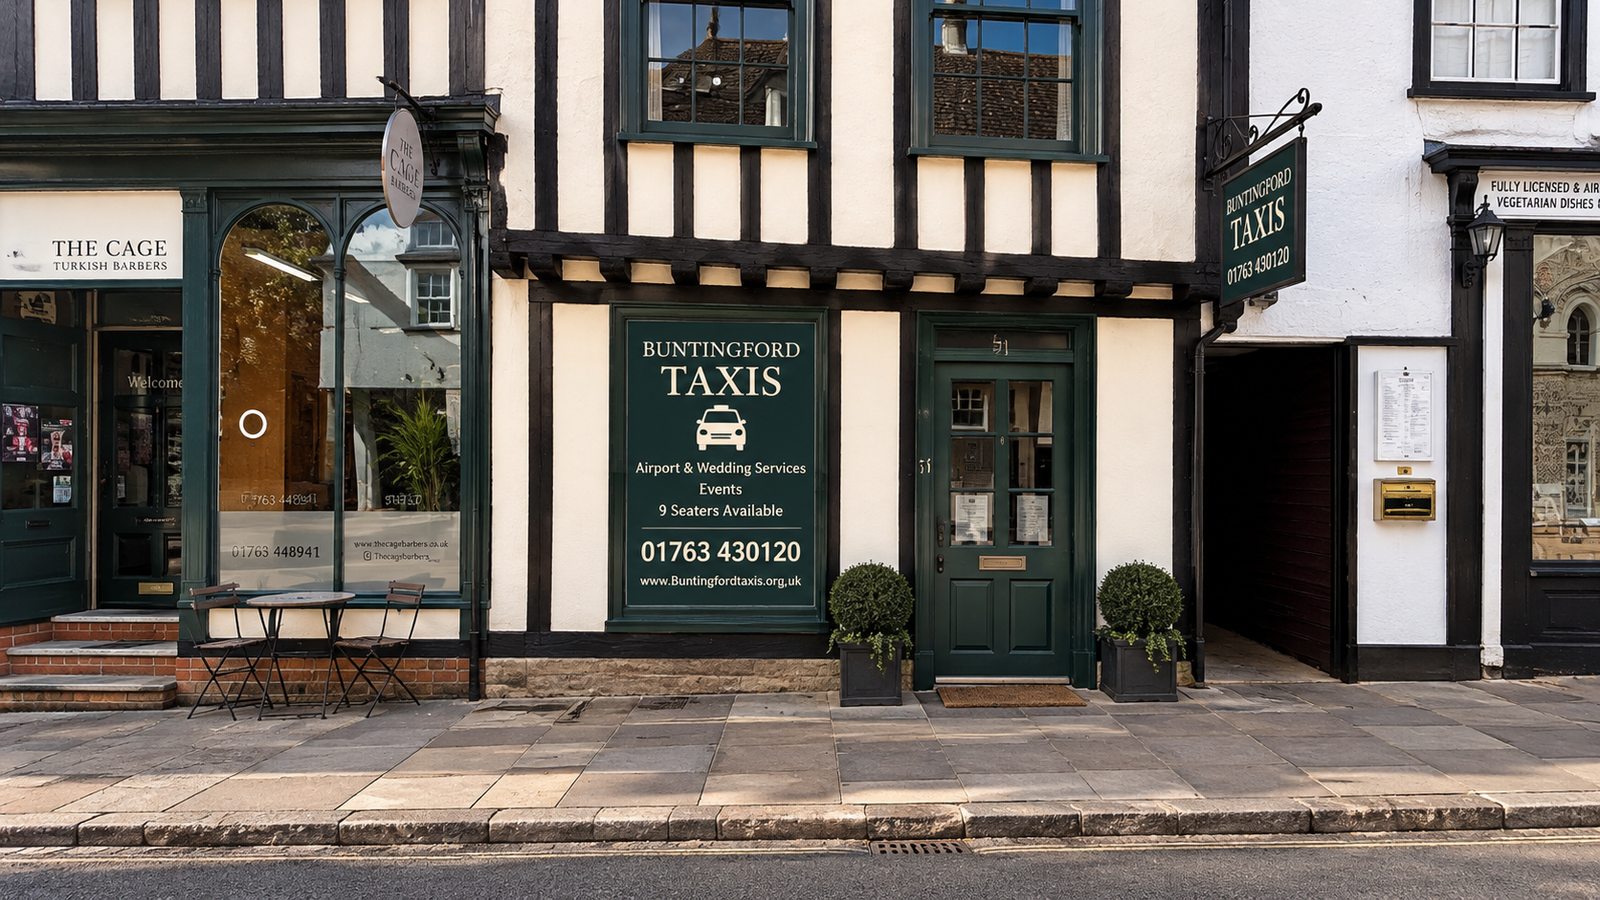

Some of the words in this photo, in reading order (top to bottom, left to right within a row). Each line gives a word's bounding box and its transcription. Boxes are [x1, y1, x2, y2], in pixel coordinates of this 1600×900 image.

[400, 137, 413, 160] THE
[390, 148, 420, 189] CAGE
[1226, 167, 1292, 216] BUNTINGFORD
[1491, 180, 1521, 192] FULLY
[1523, 181, 1570, 193] LICENSED
[1573, 182, 1580, 193] &
[1583, 183, 1600, 193] AIR
[1497, 197, 1557, 208] VEGETARIAN
[1560, 198, 1594, 209] DISHES
[1230, 195, 1286, 251] TAXIS
[52, 240, 98, 256] THE
[106, 240, 167, 256] CAGE
[53, 261, 108, 271] TURKISH
[113, 261, 168, 271] BARBERS
[1227, 261, 1253, 285] 01763
[1254, 245, 1290, 274] 430120
[643, 341, 800, 358] BUNTINGFORD
[128, 376, 183, 389] Welcome
[660, 366, 782, 397] TAXIS
[635, 462, 680, 476] Airport
[683, 462, 694, 474] &
[697, 462, 752, 477] Wedding
[755, 462, 807, 474] Services
[699, 483, 743, 495] Events
[658, 504, 667, 517] 9
[671, 504, 720, 516] Seaters
[723, 504, 783, 516] Available
[231, 545, 269, 558] 01763
[273, 545, 320, 558] 448941
[641, 541, 711, 562] 01763
[717, 541, 801, 562] 430120
